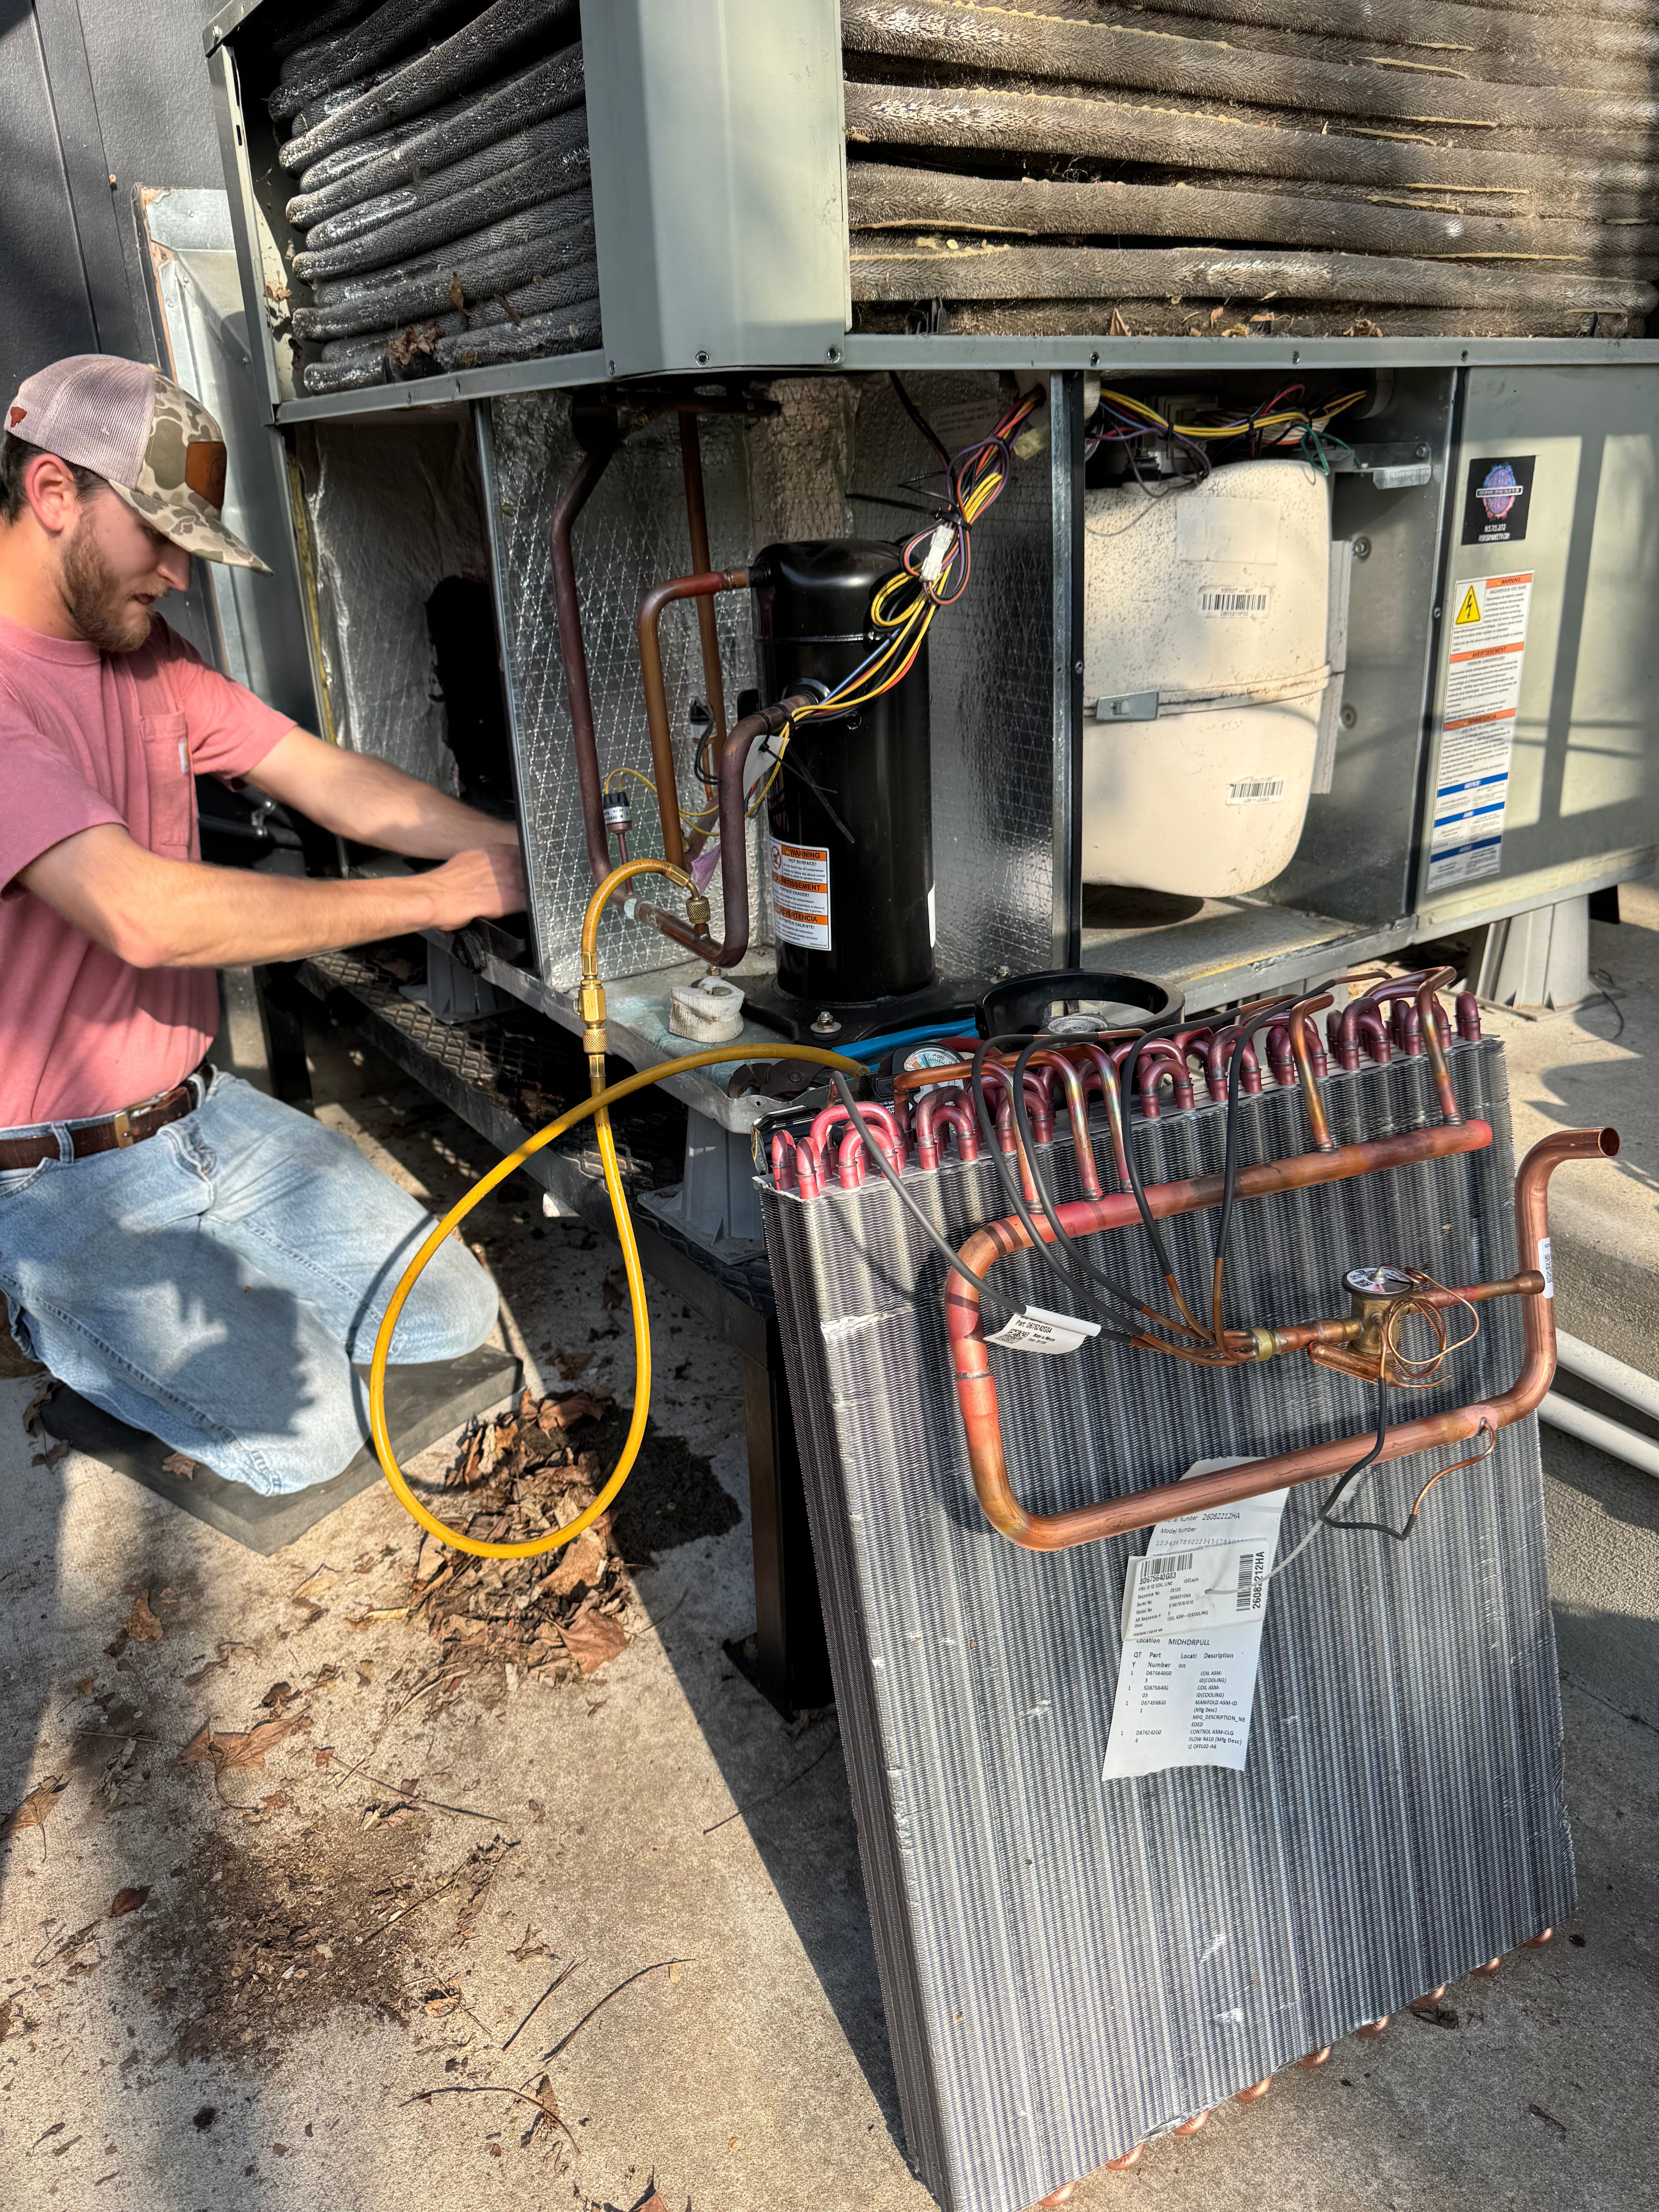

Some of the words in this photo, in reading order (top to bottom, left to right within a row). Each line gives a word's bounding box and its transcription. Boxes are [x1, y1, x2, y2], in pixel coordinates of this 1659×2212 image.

[1464, 780, 1482, 789] NOTICE
[790, 849, 820, 859] WARNING
[776, 876, 820, 891] ERTISSEMENT
[1202, 1512, 1240, 1520] 26082212HA
[1140, 1572, 1176, 1585] SD675640G03
